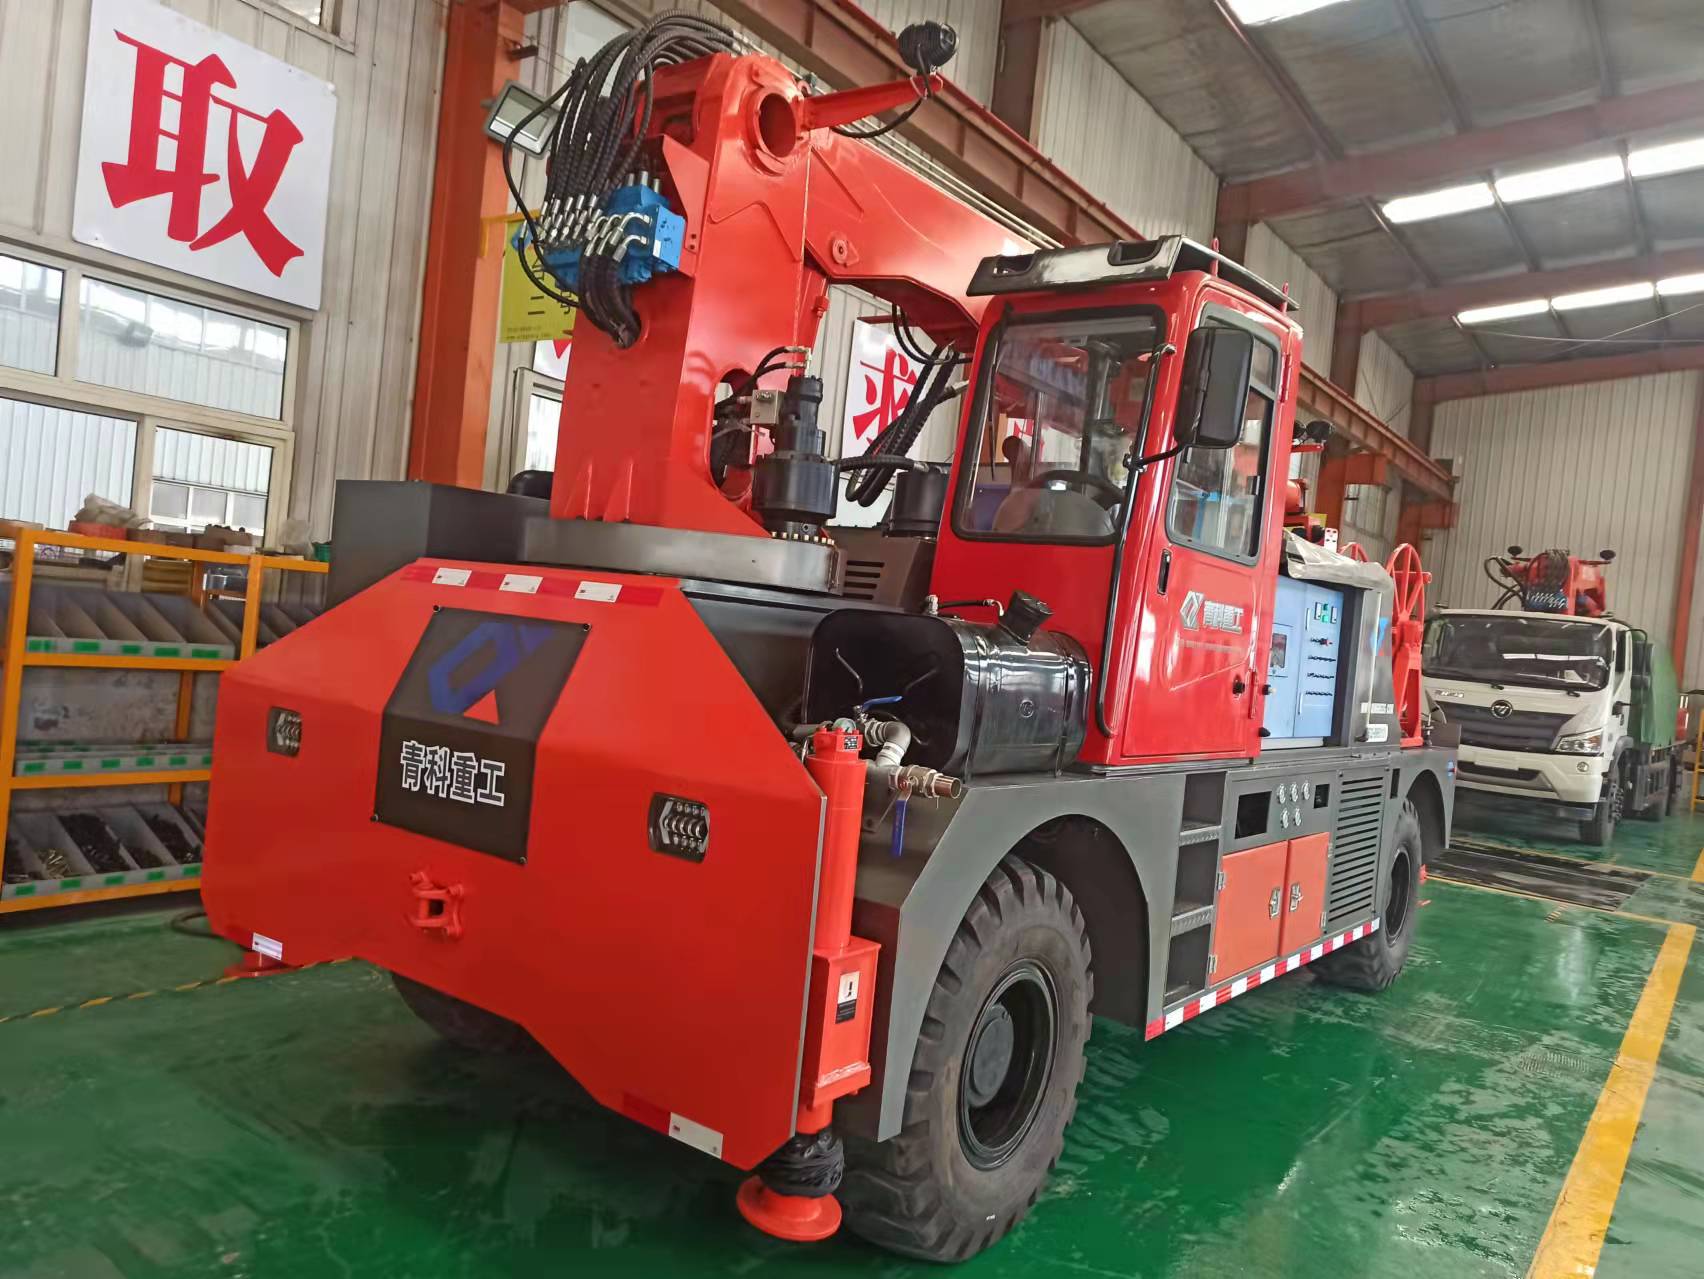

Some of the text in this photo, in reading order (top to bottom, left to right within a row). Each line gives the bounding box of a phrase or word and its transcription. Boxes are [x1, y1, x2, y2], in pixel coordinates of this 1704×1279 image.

[101, 29, 305, 278] 取
[853, 348, 920, 455] 求
[400, 740, 505, 807] 青科重工
